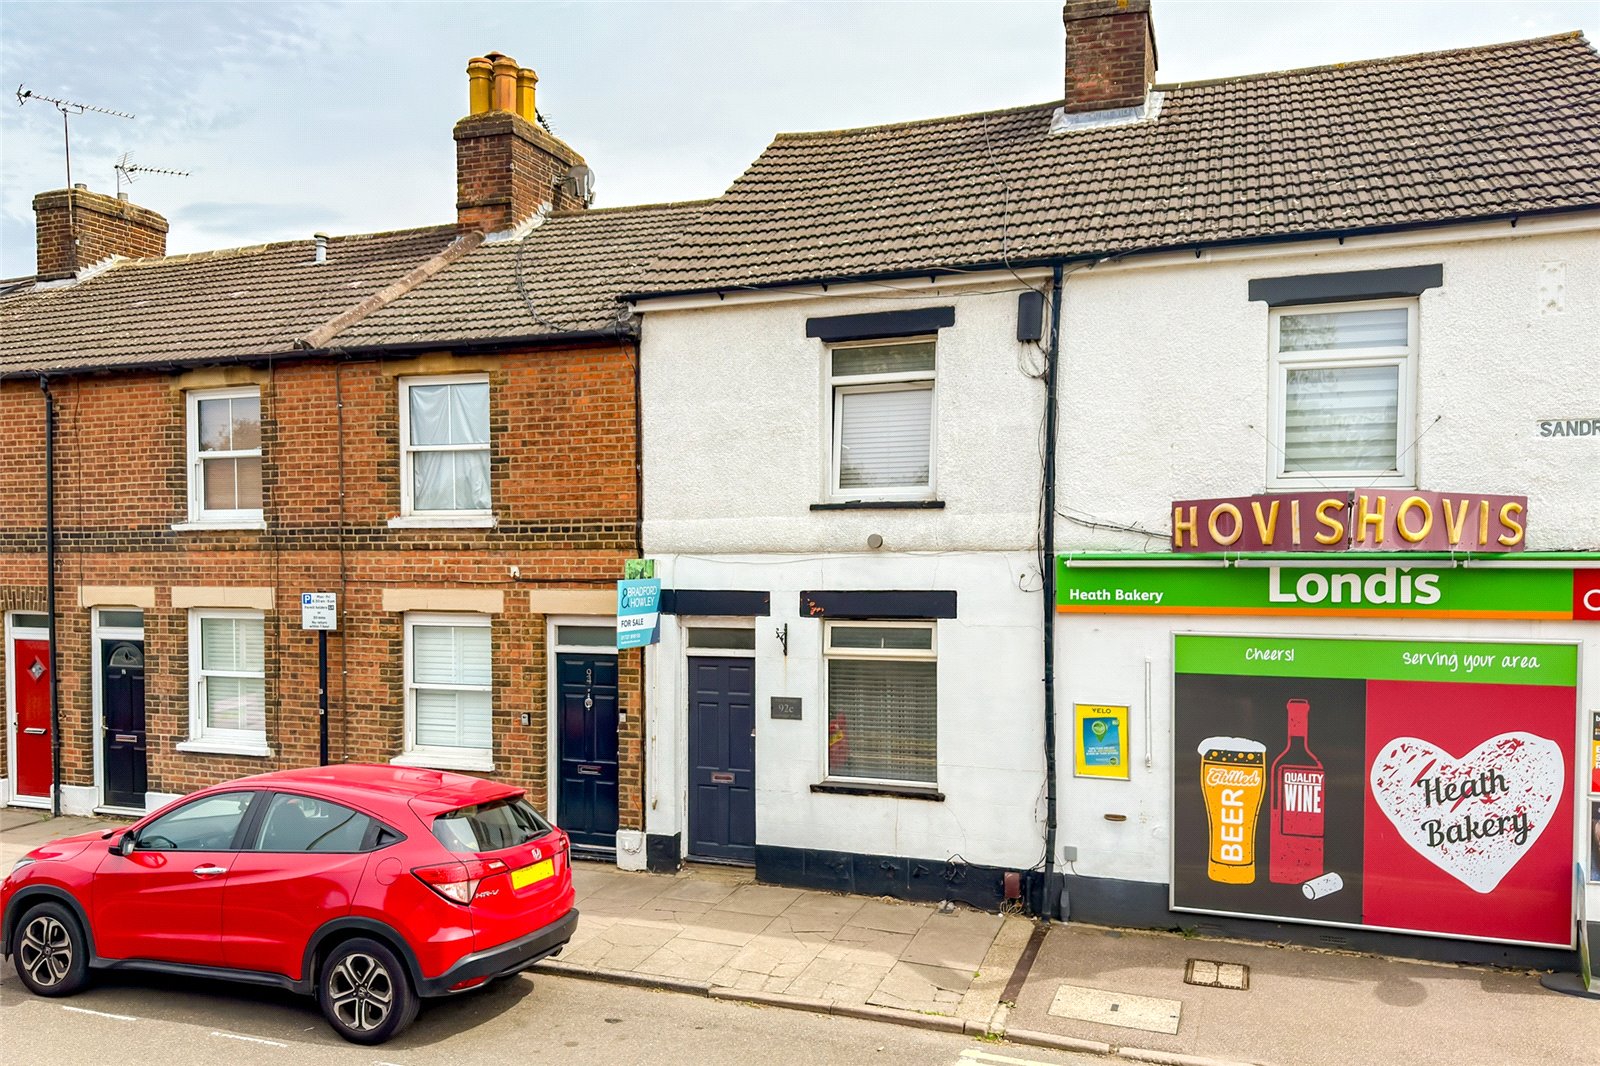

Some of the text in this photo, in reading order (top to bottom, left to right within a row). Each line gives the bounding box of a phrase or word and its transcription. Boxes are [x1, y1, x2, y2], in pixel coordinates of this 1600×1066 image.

[1174, 495, 1524, 547] HOVIS HOVIS
[627, 585, 657, 597] BRADFORD
[1269, 566, 1442, 605] Londis
[630, 596, 655, 608] HOWLEY
[1069, 588, 1164, 604] Heath Bakery
[621, 617, 644, 628] FOR SALE
[1245, 647, 1295, 661] Cheers!
[1463, 654, 1496, 673] your
[1501, 655, 1541, 668] area
[1284, 772, 1324, 784] QUALITY
[1417, 768, 1509, 807] Heath
[1284, 784, 1322, 813] WINE
[1220, 788, 1244, 862] BEER
[1421, 812, 1534, 848] Bakery
[475, 888, 499, 899] HR-V
